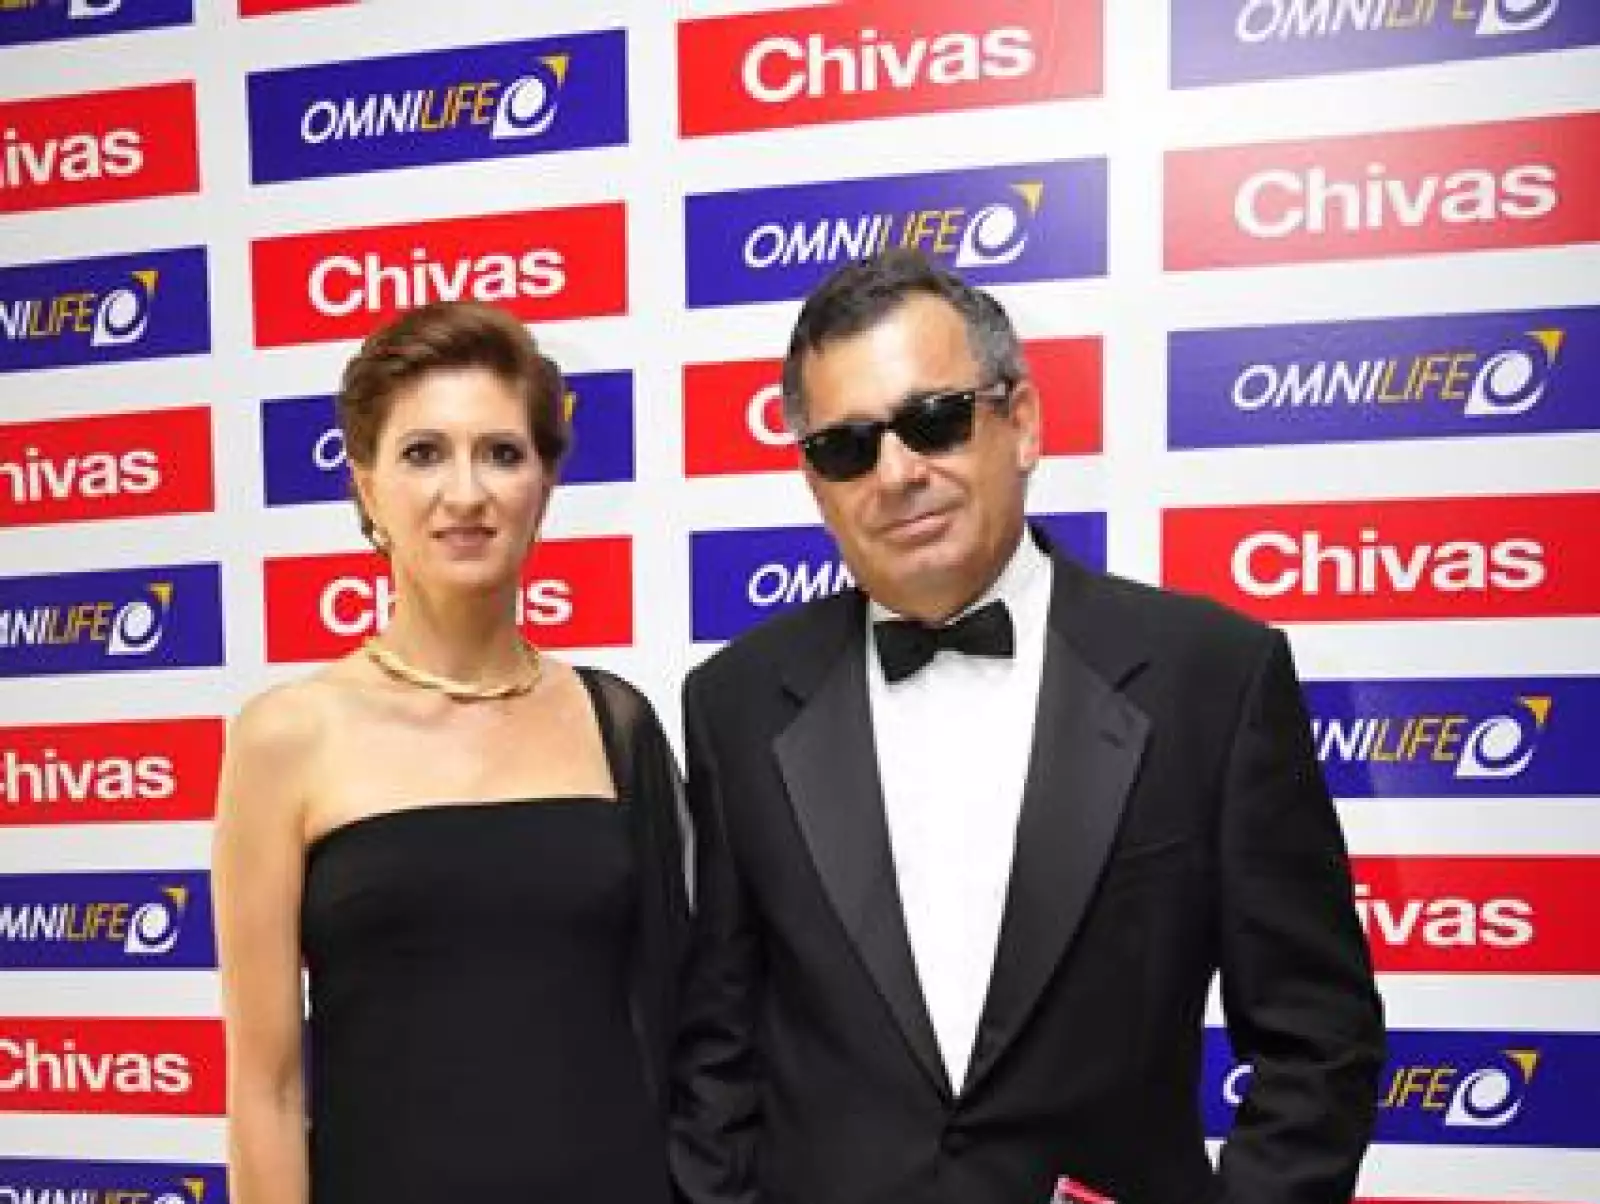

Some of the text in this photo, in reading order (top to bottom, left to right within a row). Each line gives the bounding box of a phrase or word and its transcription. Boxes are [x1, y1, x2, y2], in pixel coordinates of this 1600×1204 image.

[741, 26, 1036, 103] Chivas
[300, 81, 501, 144] OMNILIFE
[0, 127, 144, 190] ivas
[1234, 161, 1558, 238] Chivas
[308, 248, 566, 317] Chivas
[0, 293, 98, 340] NILIFE
[1231, 353, 1477, 411] OMNILIFE
[0, 446, 161, 505] ivas
[1231, 528, 1547, 598] Chivas
[1310, 715, 1469, 762] NILIFE
[0, 749, 177, 803] hivas
[0, 903, 130, 941] MNILIFE
[1354, 884, 1534, 948] ivas
[0, 1038, 193, 1093] Chivas
